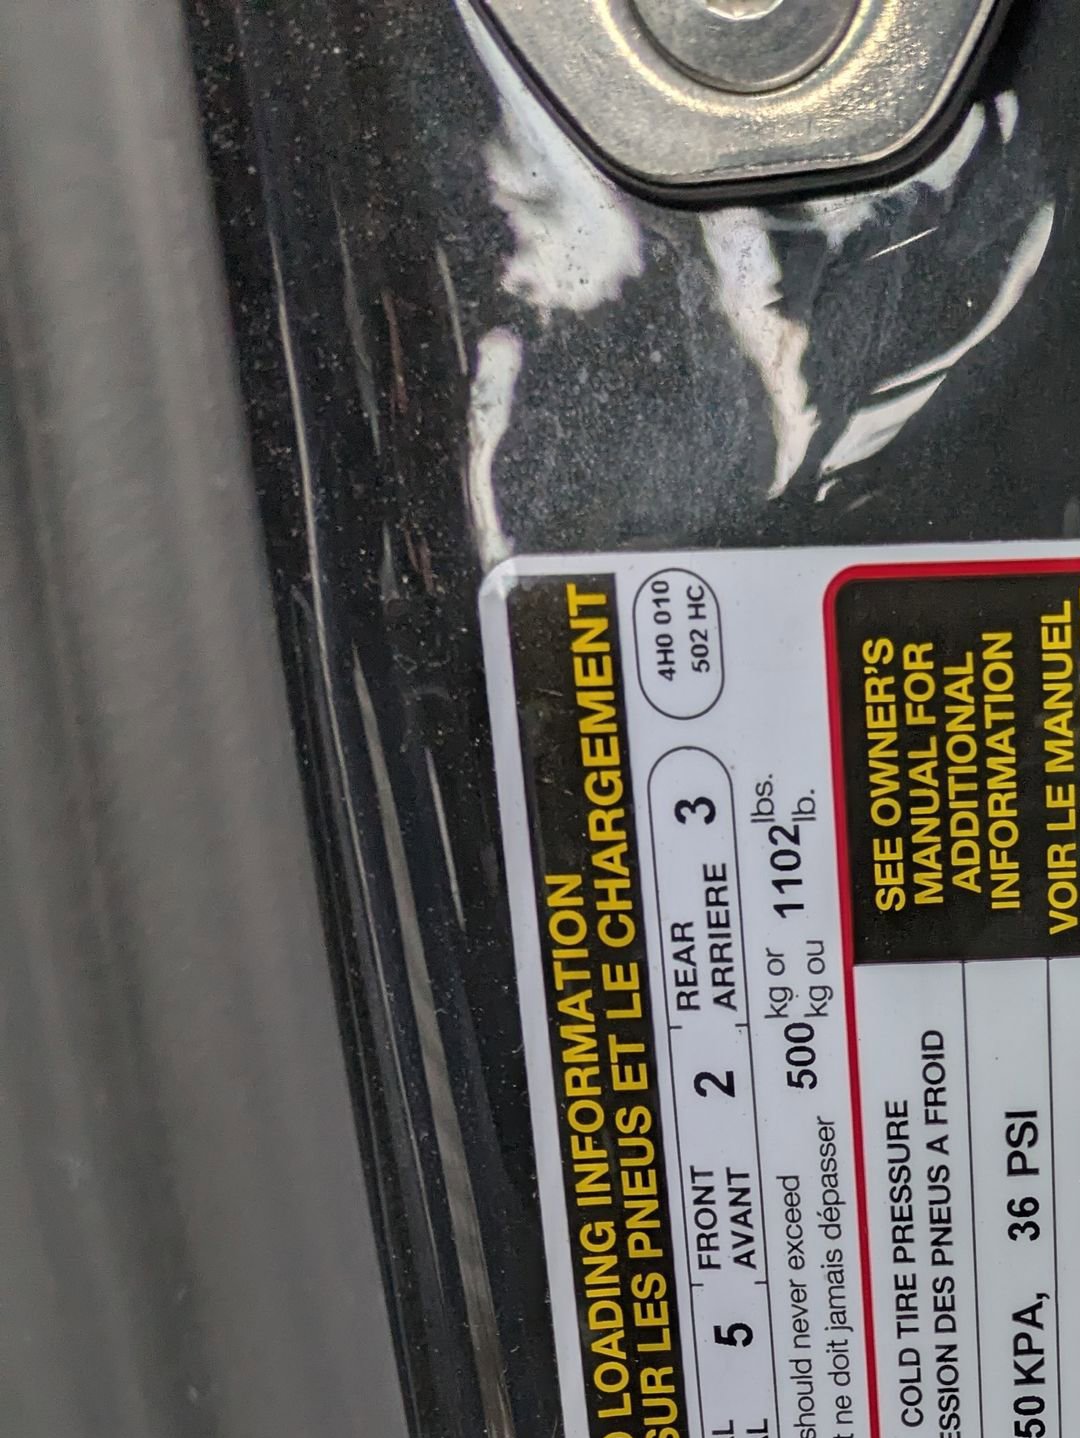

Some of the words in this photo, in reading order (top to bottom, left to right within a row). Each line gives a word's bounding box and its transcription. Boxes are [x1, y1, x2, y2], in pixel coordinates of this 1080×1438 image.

[651, 581, 671, 624] 010
[687, 586, 706, 619] HC
[656, 634, 676, 681] 4H0
[690, 629, 710, 672] 502
[903, 643, 936, 725] FOR
[1041, 600, 1074, 772] MANUEL
[566, 582, 635, 947] CHARGEMENT
[862, 638, 901, 826] OWNER'S
[751, 774, 775, 823] lbs.
[792, 790, 816, 822] lb.
[944, 652, 981, 893] ADDITIONAL
[982, 632, 1020, 908] INFORMATION
[1046, 784, 1076, 830] LE
[675, 797, 716, 824] 3
[908, 736, 943, 904] MANUAL
[768, 825, 804, 918] 1102
[873, 837, 905, 911] SEE
[1047, 843, 1078, 934] VOIR
[671, 922, 700, 1010] REAR
[703, 863, 737, 1011] ARRIERE
[766, 948, 785, 976] or
[806, 941, 825, 974] ou
[602, 963, 641, 1018] LE
[765, 987, 793, 1018] kg
[804, 986, 833, 1017] kg
[545, 875, 611, 1205] INFORMATION
[608, 1035, 648, 1090] ET
[784, 1023, 817, 1089] 500
[694, 1071, 735, 1097] 2
[921, 1030, 947, 1125] FROID
[817, 1116, 846, 1240] dépasser
[926, 1135, 949, 1155] A
[1005, 1111, 1039, 1176] PSI
[615, 1106, 663, 1258] PNEUS
[690, 1166, 721, 1269] FRONT
[726, 1167, 756, 1269] AVANT
[885, 1100, 915, 1263] PRESSURE
[927, 1165, 953, 1266] PNEUS
[776, 1176, 805, 1270] exceed
[1007, 1197, 1040, 1241] 36
[580, 1221, 631, 1418] LOADING
[631, 1273, 671, 1351] LES
[789, 1279, 811, 1348] never
[821, 1249, 853, 1332] jamais
[894, 1274, 919, 1339] TIRE
[932, 1276, 956, 1333] DES
[714, 1323, 753, 1347] 5
[826, 1339, 850, 1386] doit
[1012, 1293, 1050, 1385] KPA,
[836, 1395, 853, 1424] ne
[899, 1348, 923, 1427] COLD
